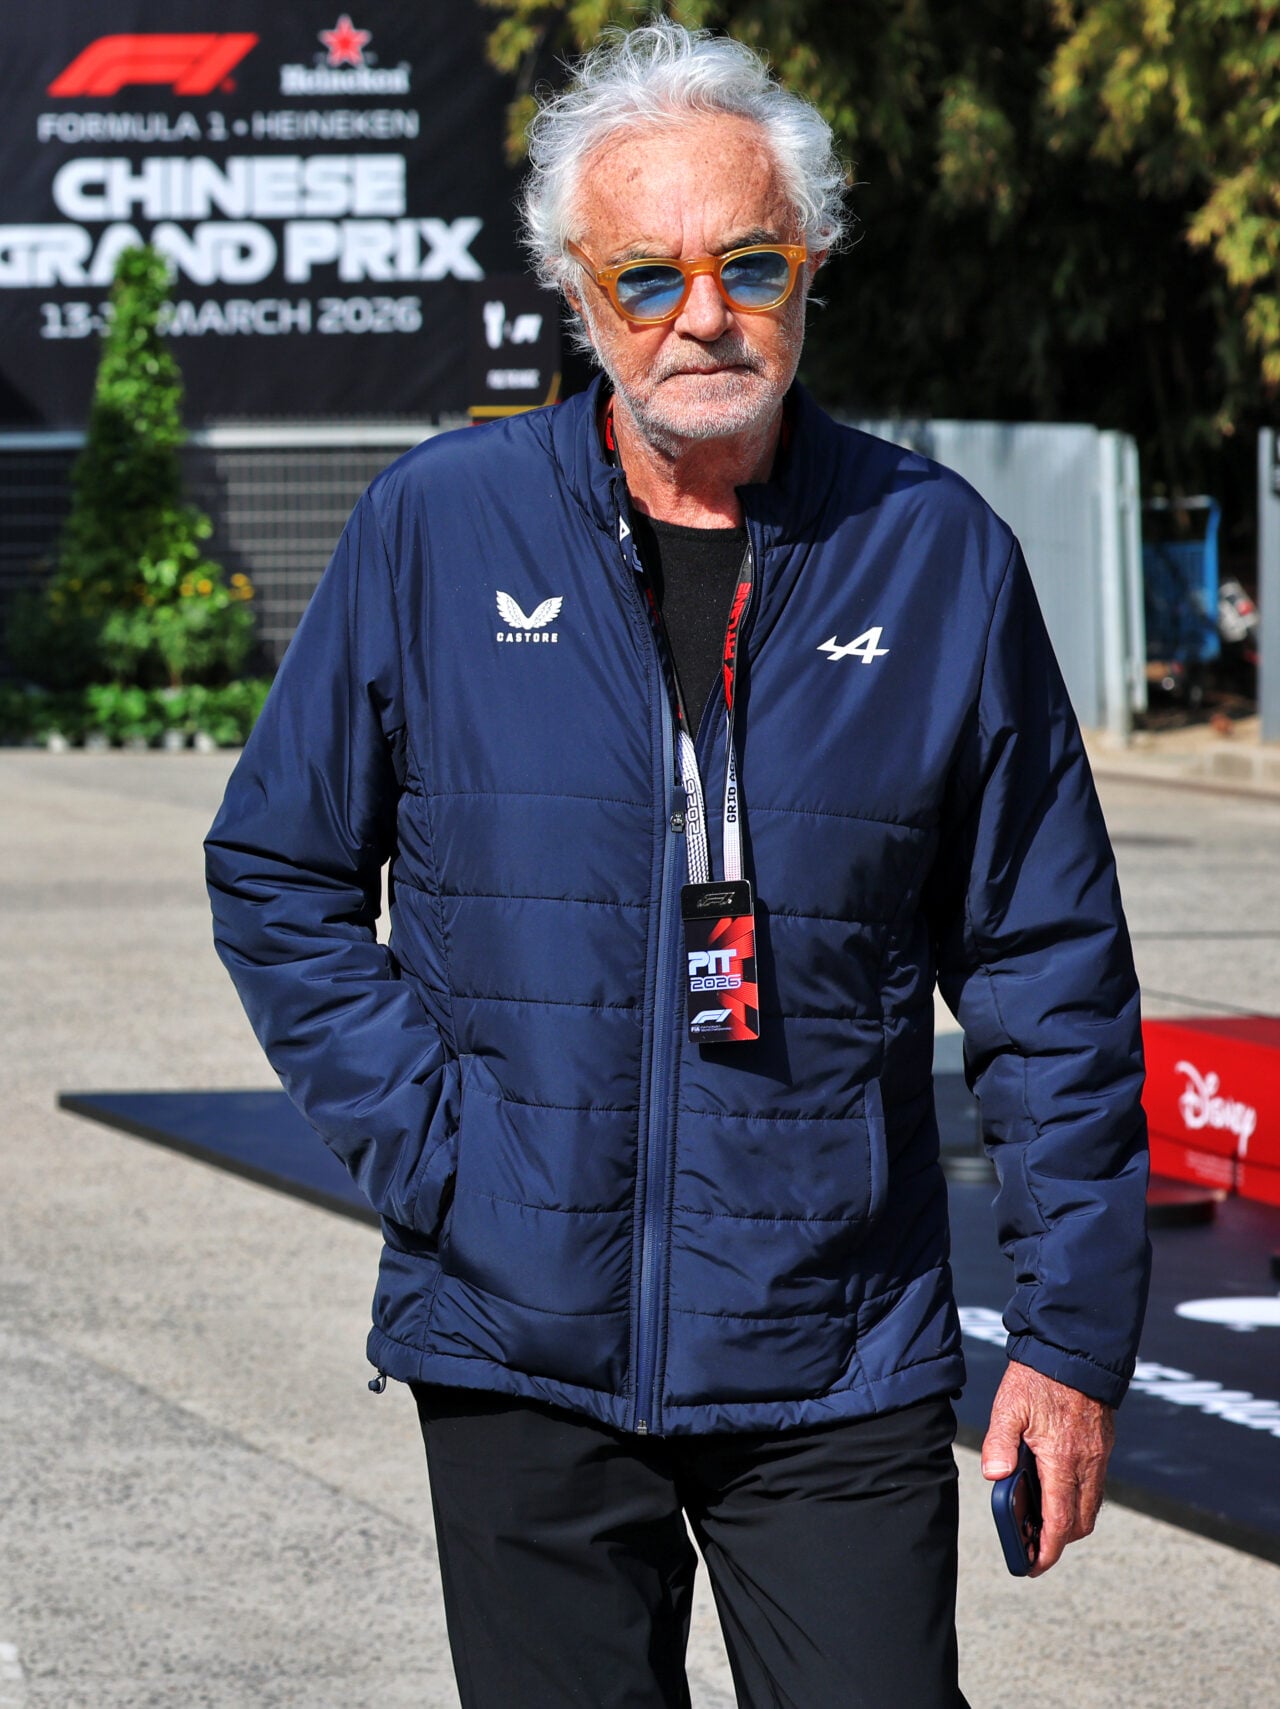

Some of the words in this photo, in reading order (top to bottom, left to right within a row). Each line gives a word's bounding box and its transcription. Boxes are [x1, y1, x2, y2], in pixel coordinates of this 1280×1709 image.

[280, 63, 411, 95] Heineken
[37, 112, 200, 143] FORMULA
[208, 111, 229, 142] 1
[252, 109, 419, 140] HEINEKEN
[52, 154, 406, 221] CHINESE
[284, 217, 483, 283] PRIX
[155, 299, 312, 336] MARCH
[317, 297, 422, 334] 2026
[496, 631, 559, 643] CASTORE
[726, 787, 737, 823] GRID
[687, 948, 737, 976] PIT
[690, 974, 741, 992] 2026
[1175, 1060, 1257, 1156] Disney
